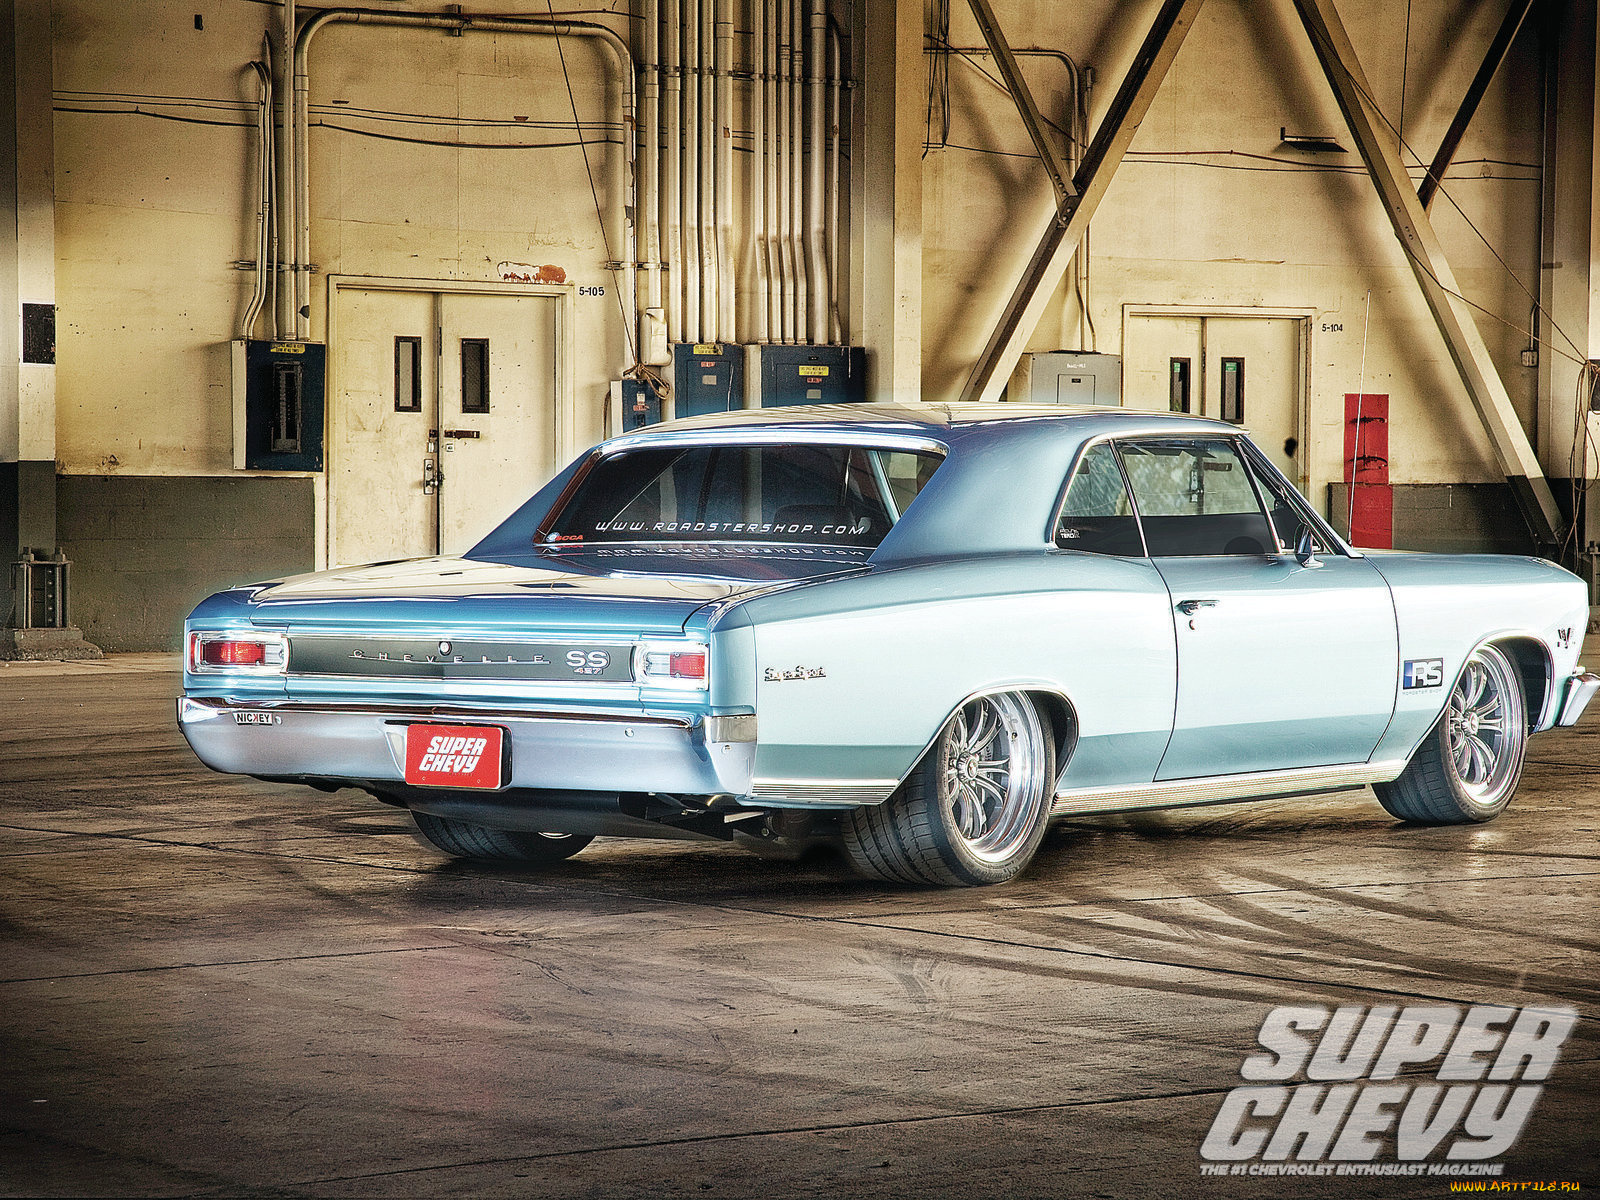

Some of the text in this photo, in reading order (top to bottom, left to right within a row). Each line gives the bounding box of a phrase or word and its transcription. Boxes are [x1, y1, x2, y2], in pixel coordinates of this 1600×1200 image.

[578, 286, 605, 296] 5-105
[1321, 323, 1343, 332] 5-104
[595, 521, 865, 535] WWW.ROADSTERSHOP.COM
[352, 649, 545, 664] CHEVELLE
[566, 650, 609, 667] SS
[574, 667, 603, 675] 427
[1411, 660, 1443, 687] RS
[426, 735, 488, 756] SUPER
[418, 753, 480, 773] CHEVY
